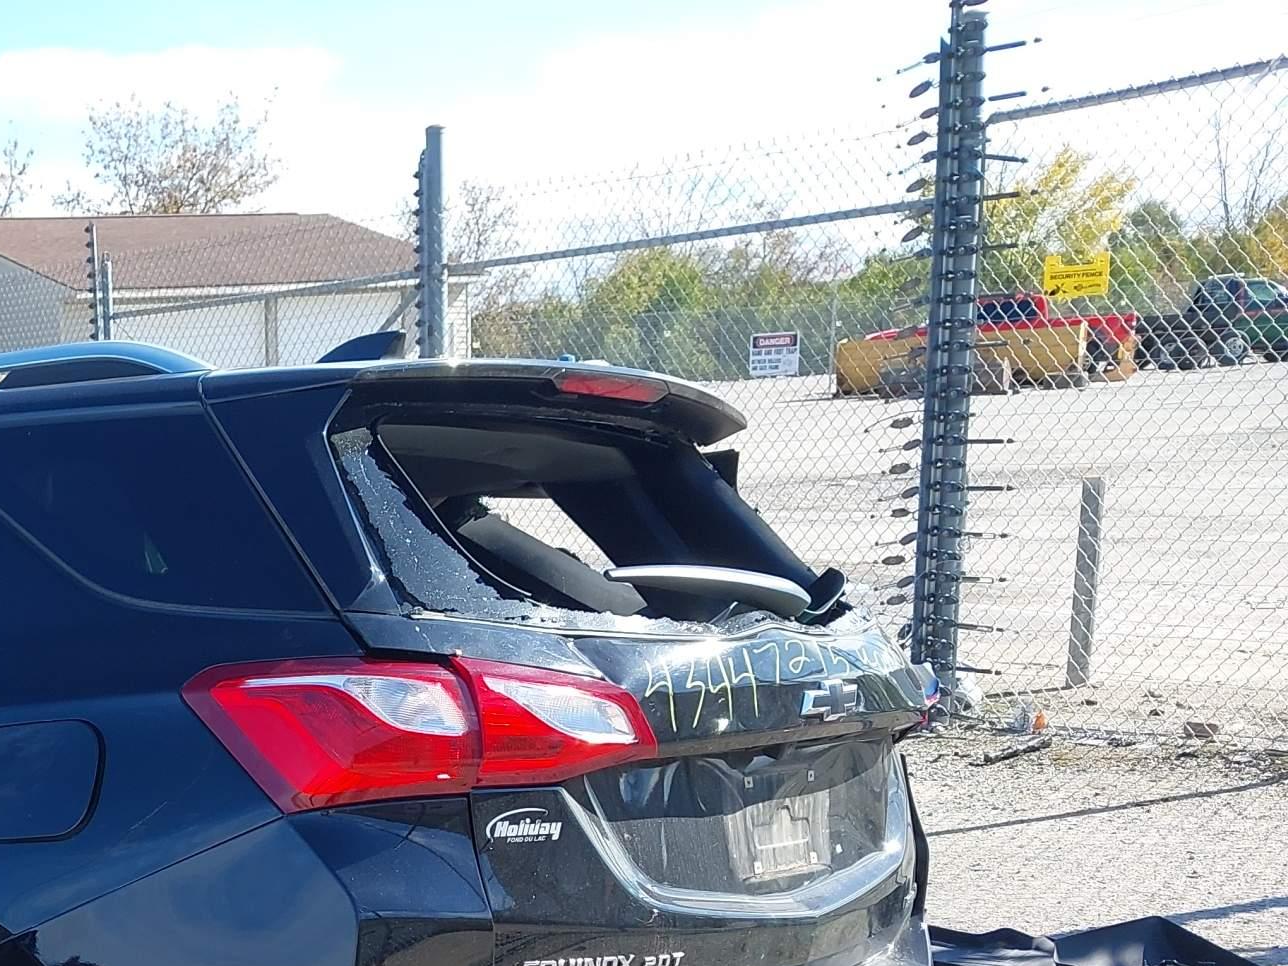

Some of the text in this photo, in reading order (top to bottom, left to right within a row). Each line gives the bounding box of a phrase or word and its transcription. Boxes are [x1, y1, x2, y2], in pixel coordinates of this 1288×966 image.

[1050, 272, 1080, 280] SECURITY
[759, 337, 791, 346] DANGER
[494, 817, 562, 840] Holiday
